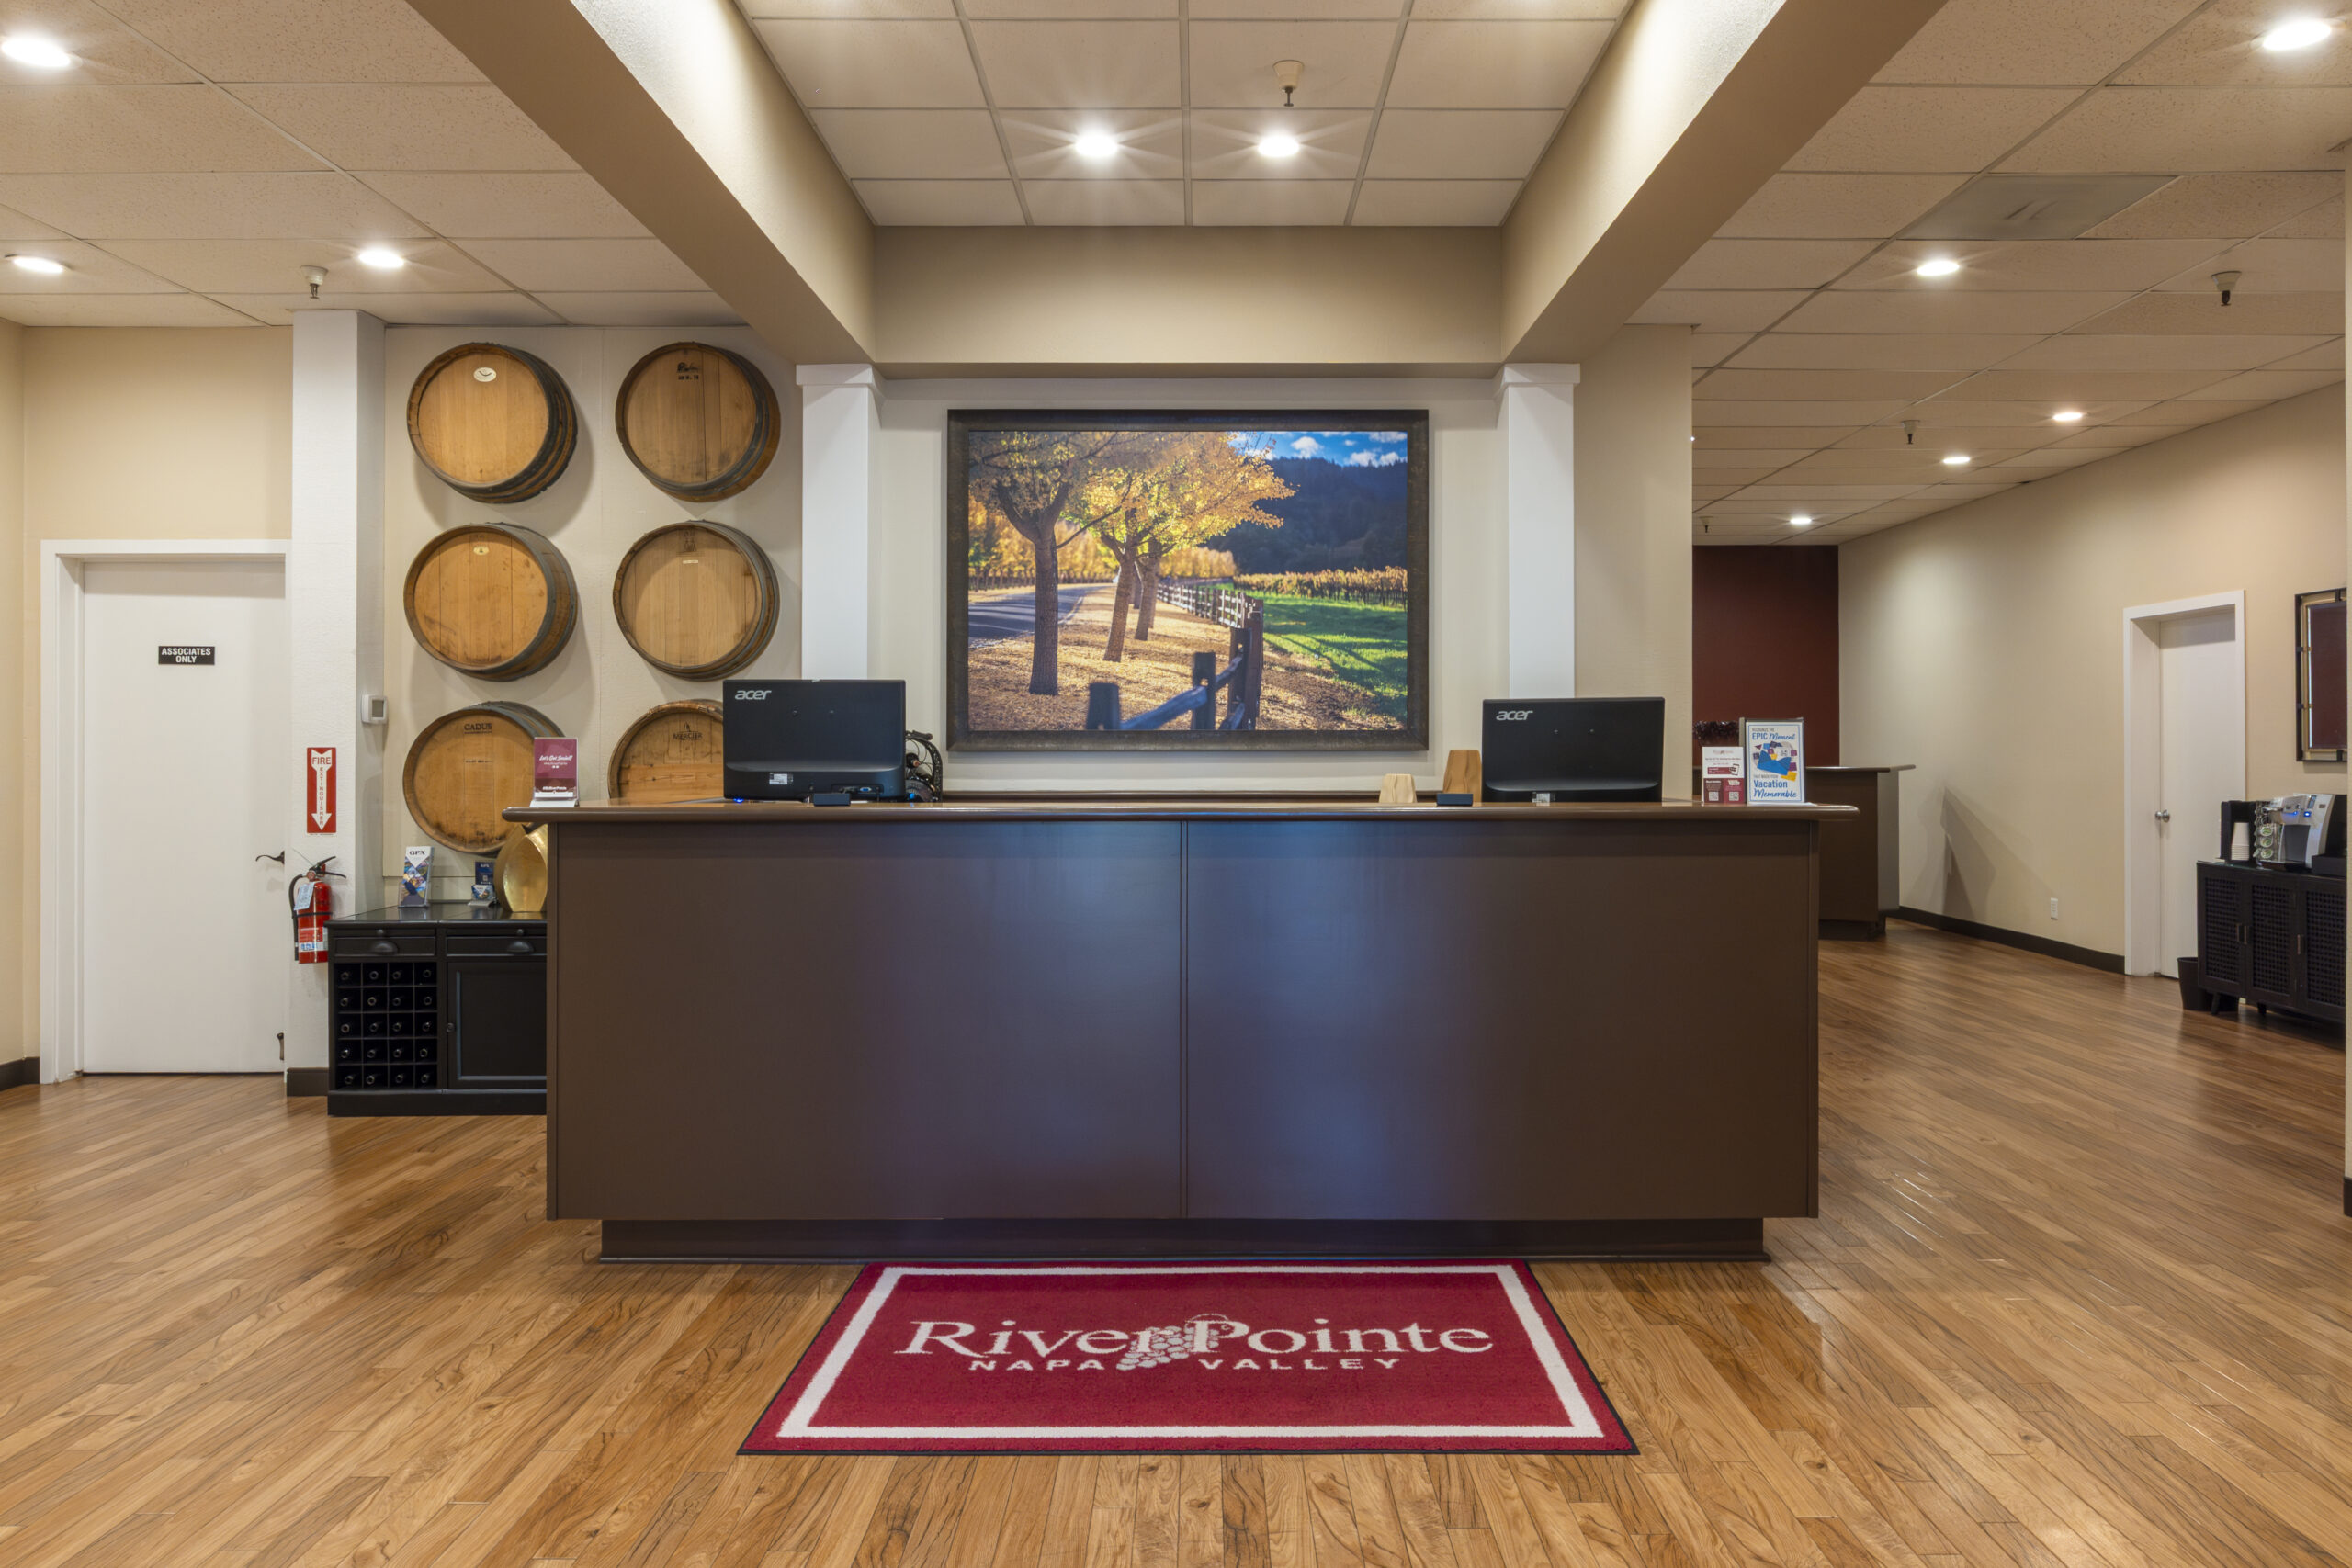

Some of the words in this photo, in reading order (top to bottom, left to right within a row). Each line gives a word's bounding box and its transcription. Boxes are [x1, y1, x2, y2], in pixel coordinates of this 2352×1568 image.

[162, 647, 211, 655] ASSOCIATES
[735, 690, 772, 700] acer
[1496, 710, 1533, 721] acer
[1752, 732, 1768, 740] EPIC
[1770, 732, 1796, 740] Moment
[1754, 780, 1788, 788] Vacation
[1753, 788, 1798, 798] Memorable
[968, 1359, 1105, 1371] NAPA
[1198, 1359, 1400, 1371] VALLEY
